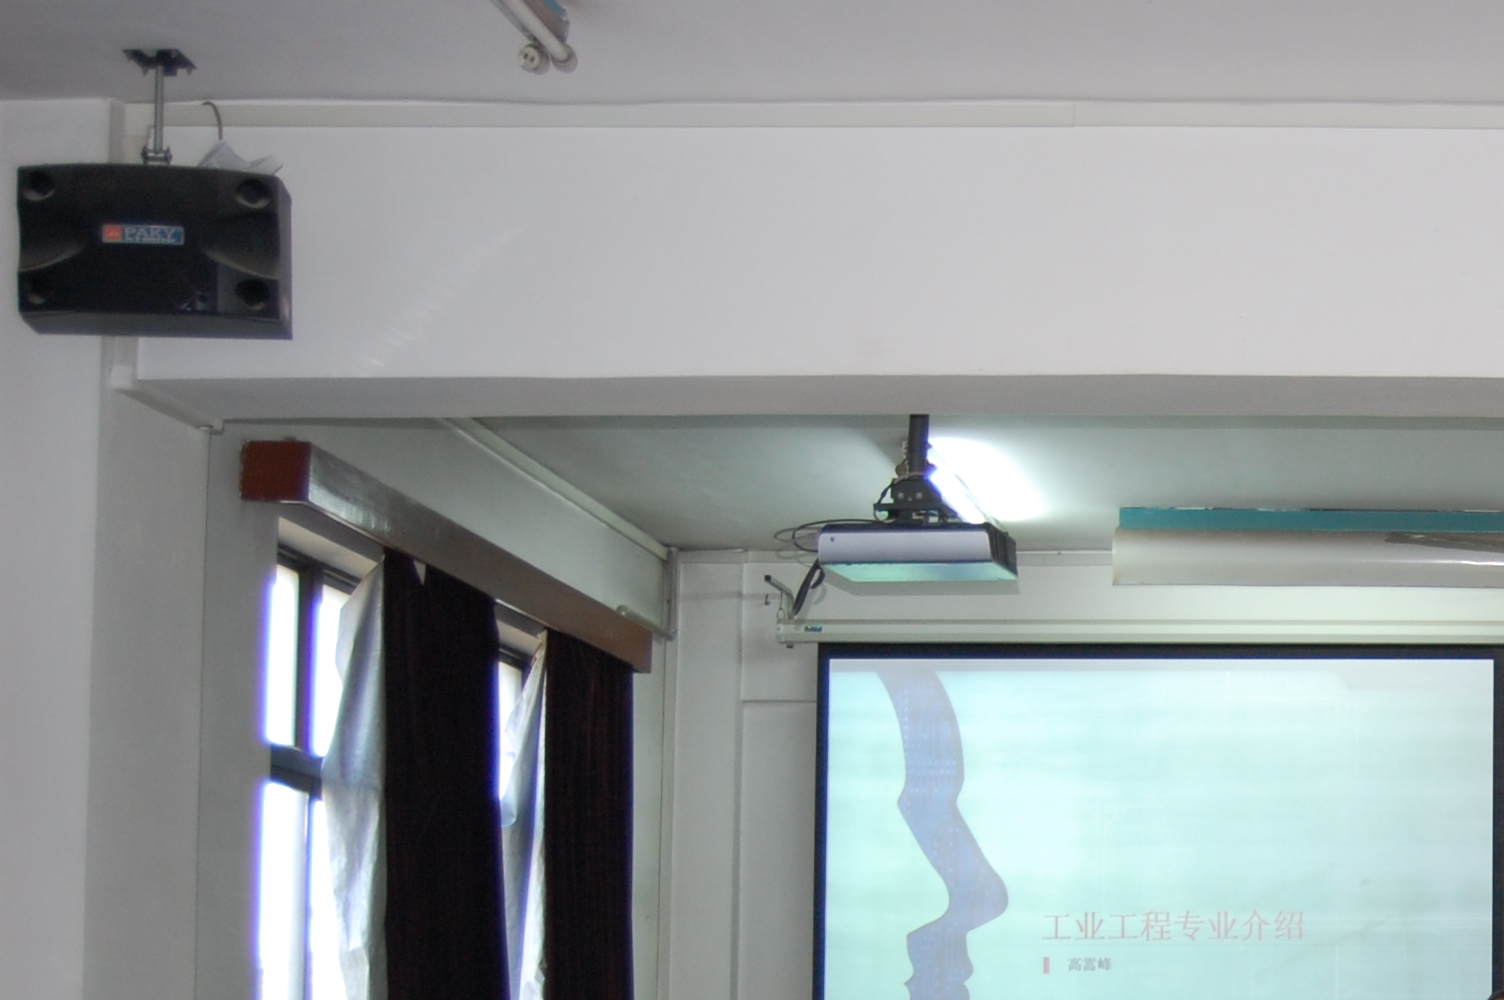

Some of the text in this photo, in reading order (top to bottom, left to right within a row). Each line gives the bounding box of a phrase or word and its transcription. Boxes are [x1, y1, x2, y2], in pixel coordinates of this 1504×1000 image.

[1042, 910, 1305, 942] 工业工程专业介绍
